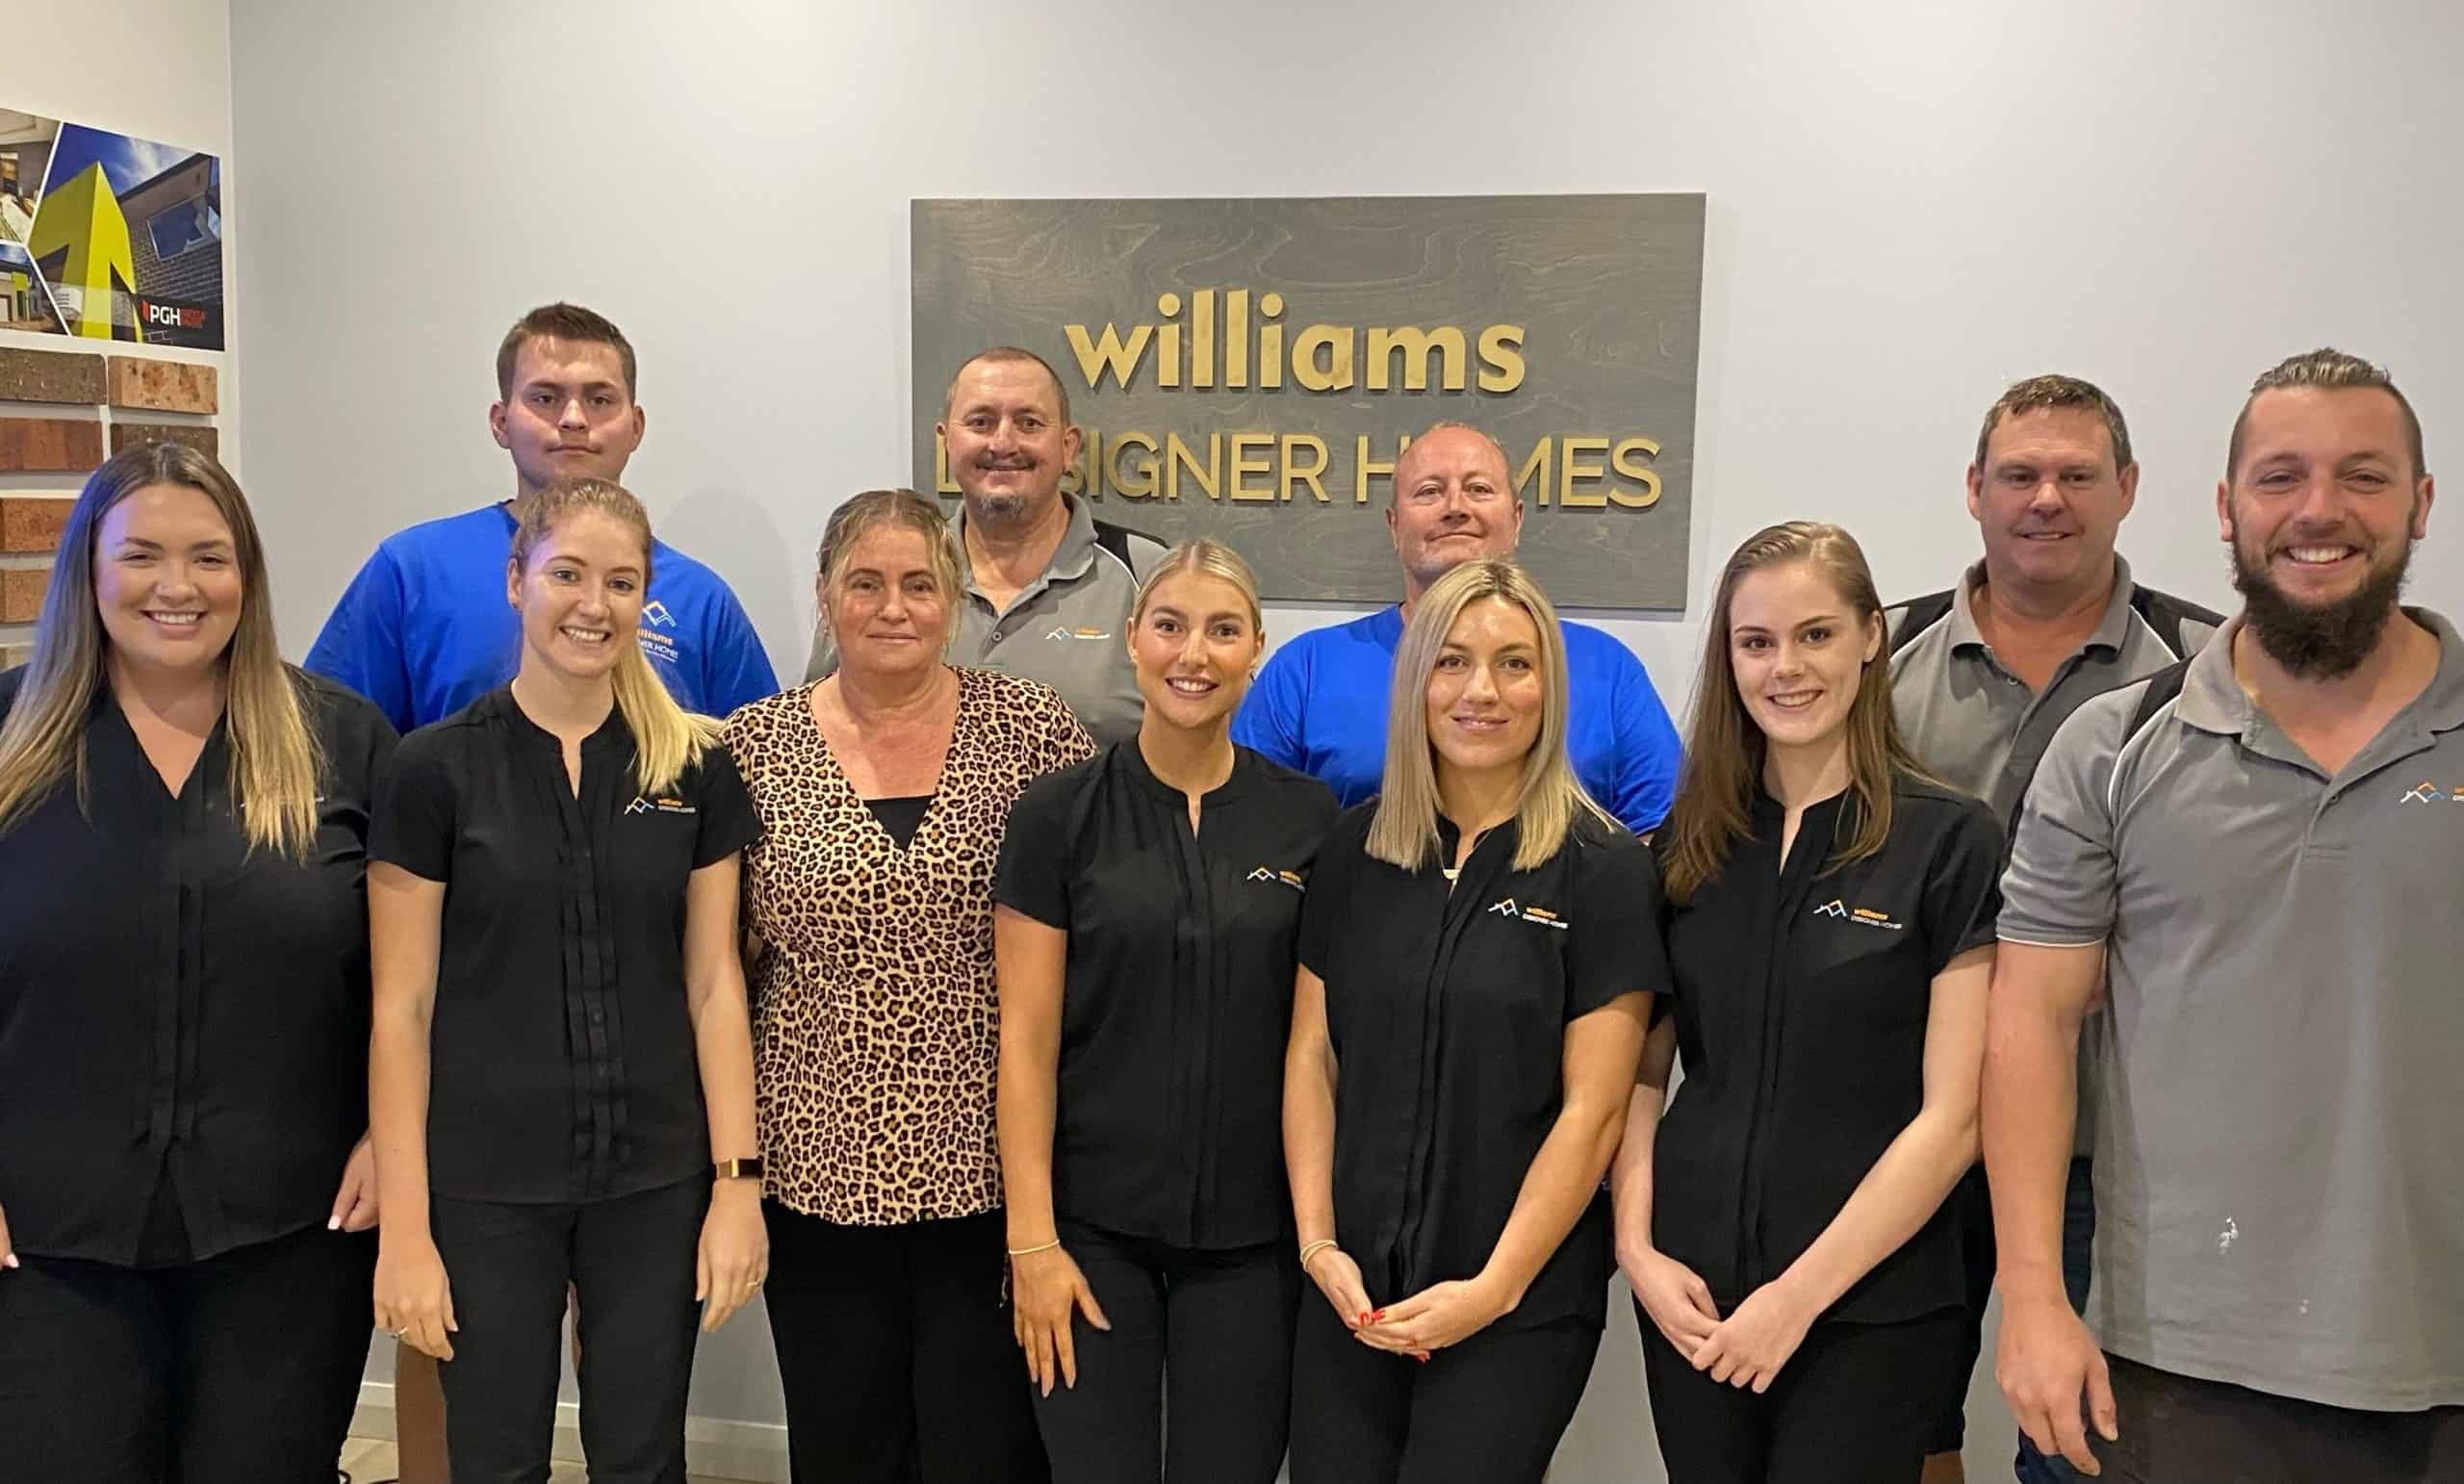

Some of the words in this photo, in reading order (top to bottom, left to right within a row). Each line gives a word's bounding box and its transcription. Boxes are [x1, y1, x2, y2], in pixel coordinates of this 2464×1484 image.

[149, 304, 181, 326] PGH
[1064, 289, 1527, 393] williams
[936, 430, 1331, 503] IGNER
[1356, 435, 1663, 508] HMES
